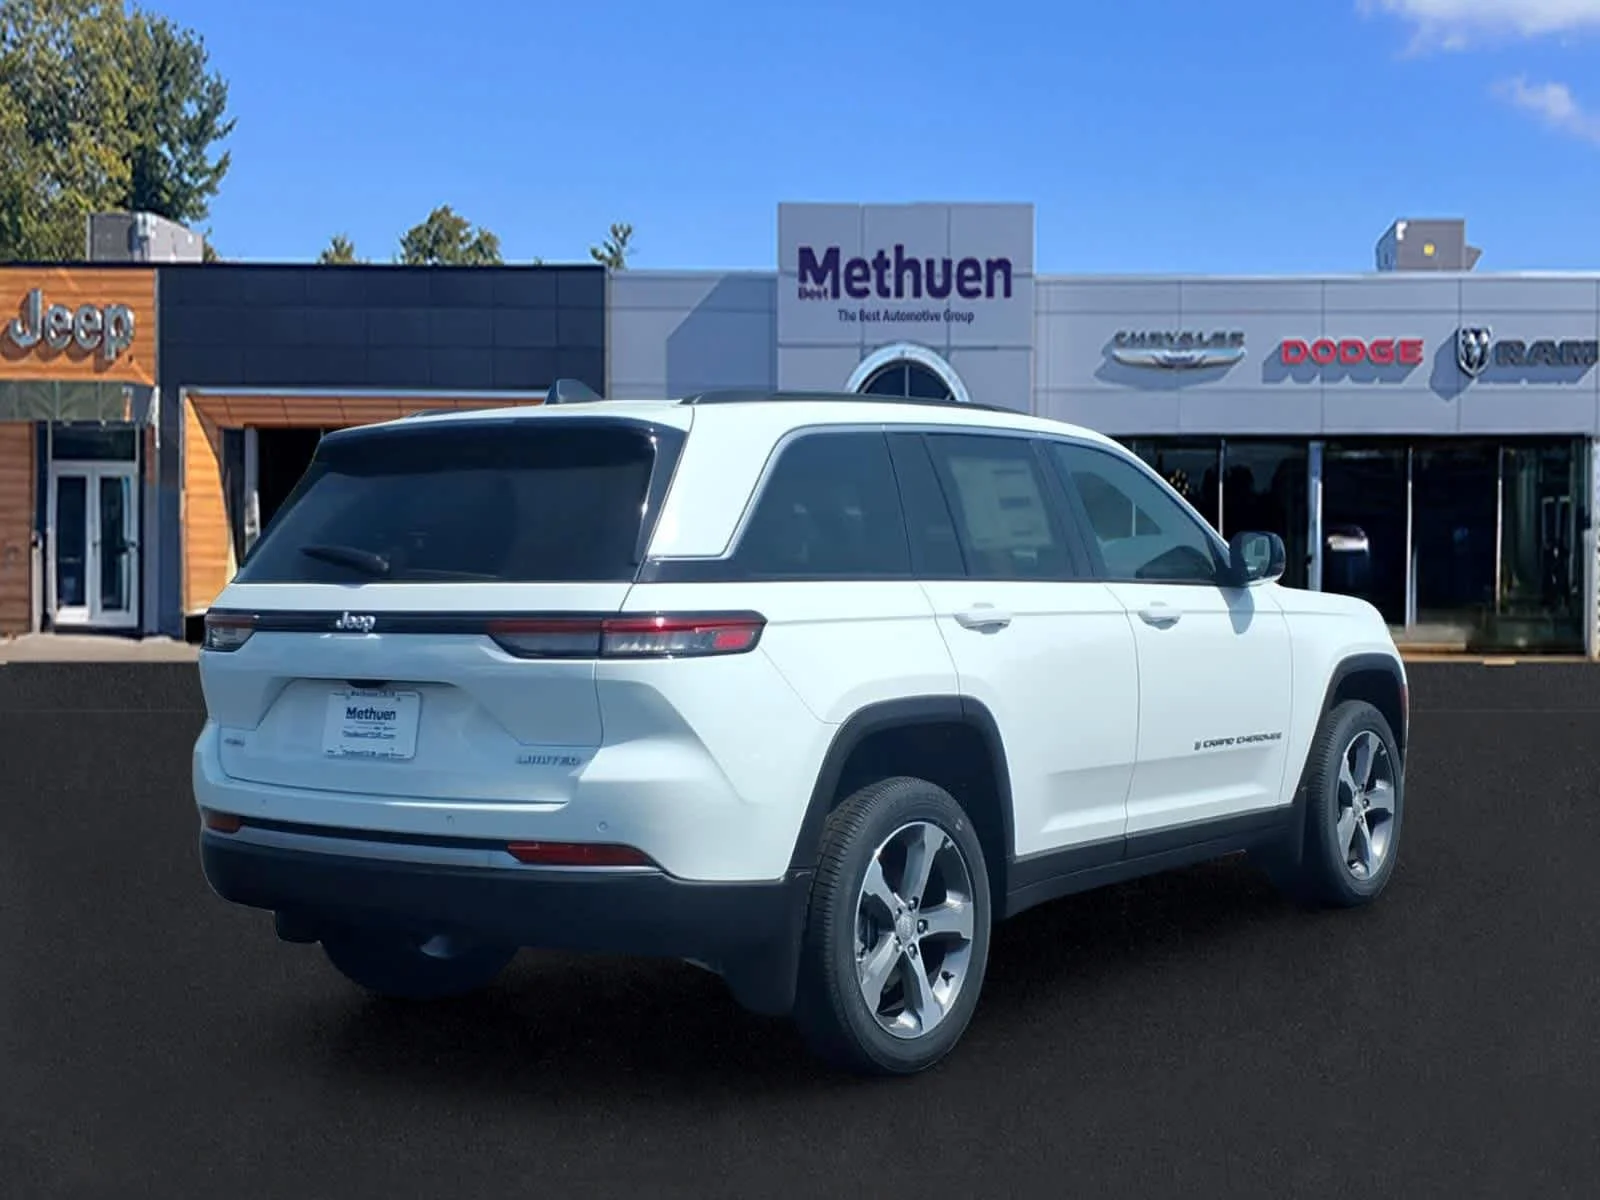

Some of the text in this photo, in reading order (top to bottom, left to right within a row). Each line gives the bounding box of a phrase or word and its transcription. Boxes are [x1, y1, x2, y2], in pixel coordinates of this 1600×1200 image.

[797, 243, 1012, 299] Methuen
[9, 288, 135, 360] Jeep
[838, 307, 975, 325] The Best Automotive Group
[1114, 330, 1246, 347] CHRYSLER
[1281, 338, 1424, 365] DODGE
[1495, 339, 1599, 367] RAM
[335, 610, 377, 633] Jeep
[345, 706, 398, 721] Methuen
